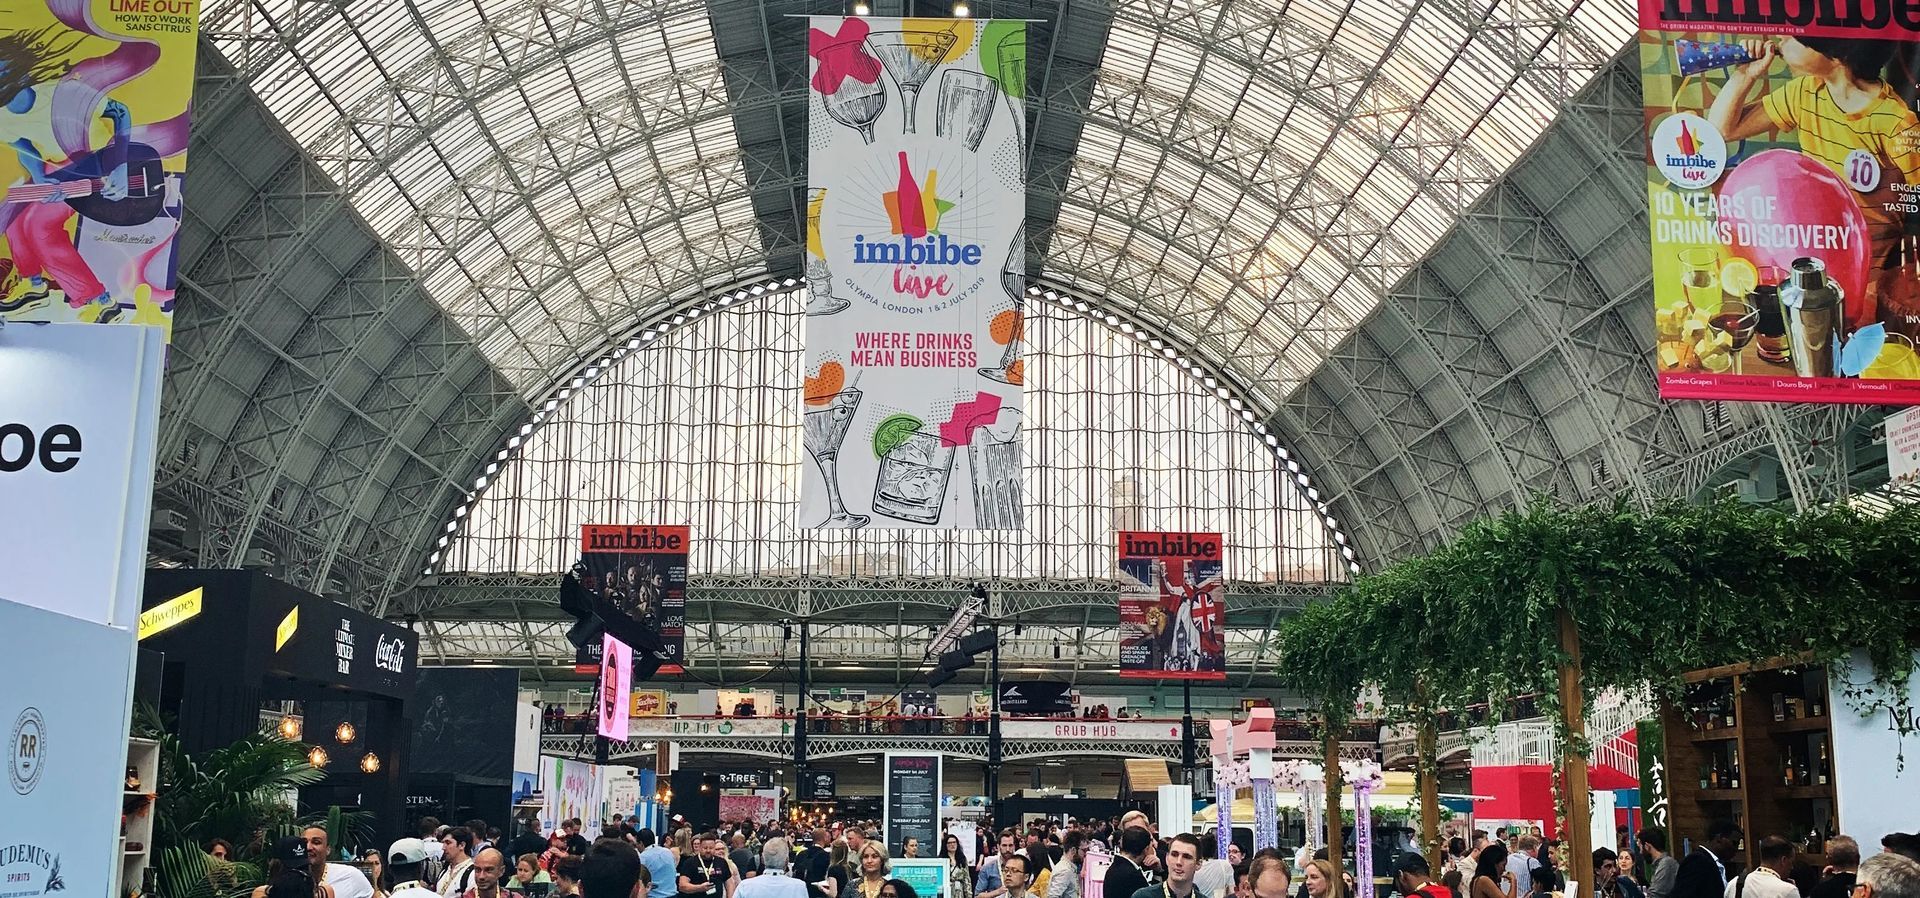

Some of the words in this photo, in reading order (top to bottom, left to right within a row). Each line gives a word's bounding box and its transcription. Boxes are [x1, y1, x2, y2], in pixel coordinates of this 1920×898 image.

[110, 0, 150, 13] LIME
[153, 0, 194, 15] OUT
[115, 14, 141, 22] HOW
[143, 15, 157, 23] TO
[159, 15, 192, 25] WORK
[126, 23, 152, 31] SANS
[153, 23, 191, 34] CITRUS
[1666, 154, 1717, 169] imbibe
[1683, 167, 1707, 181] live
[1850, 158, 1873, 187] 10
[1655, 191, 1674, 216] 10
[1681, 193, 1745, 219] YEARS
[1752, 196, 1777, 220] OF
[1898, 193, 1916, 203] 2018
[1883, 203, 1918, 213] TASTED
[1656, 219, 1732, 245] DRINKS
[1737, 223, 1850, 250] DISCOVERY
[854, 234, 982, 265] imbibe
[893, 262, 954, 299] live
[845, 278, 879, 306] OLYMPIA
[882, 302, 923, 315] LONDON
[949, 291, 968, 307] JULY
[969, 276, 985, 294] 2019
[855, 332, 911, 349] WHERE
[916, 333, 973, 350] DRINKS
[851, 350, 895, 367] MEAN
[900, 351, 977, 368] BUSINESS
[1666, 376, 1689, 385] Zombie
[1690, 377, 1713, 388] Grapes
[1777, 380, 1797, 388] Douro
[1798, 381, 1813, 390] Boys
[1857, 382, 1888, 391] Vermouth
[0, 423, 82, 473] oe
[589, 527, 680, 550] imbibe
[1125, 534, 1217, 557] imbibe
[1124, 564, 1160, 587] ALE
[1120, 585, 1160, 593] BRITANNIA
[140, 599, 194, 631] Schweppes
[341, 618, 351, 632] THE
[336, 641, 354, 660] MIXER
[587, 644, 602, 655] THE
[337, 658, 350, 675] BAR
[696, 721, 710, 734] TO
[1055, 725, 1086, 736] GRUB
[1093, 725, 1117, 737] HUB
[20, 733, 36, 758] RR
[7, 872, 30, 883] SPIRITS
